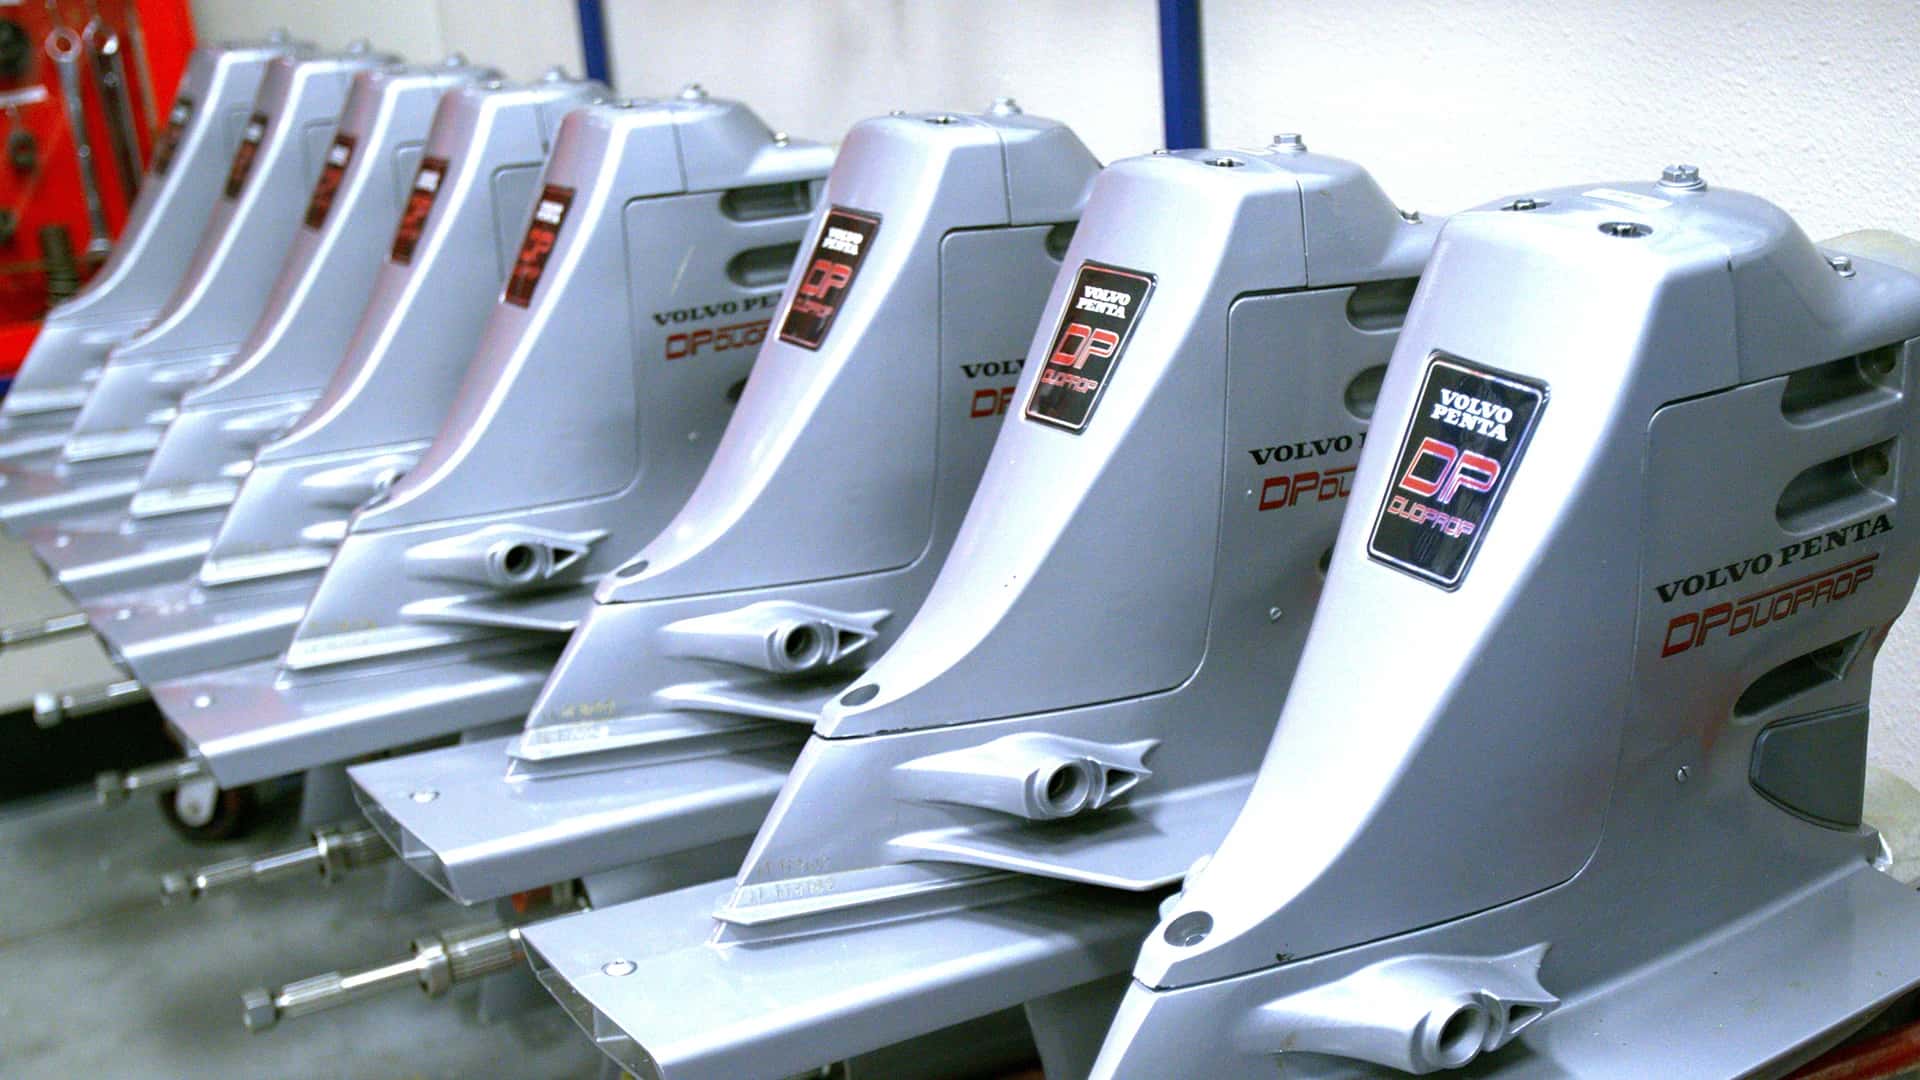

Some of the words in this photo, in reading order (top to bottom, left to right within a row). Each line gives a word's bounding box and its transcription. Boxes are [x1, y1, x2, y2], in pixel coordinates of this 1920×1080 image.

[653, 301, 738, 325] VOLVO
[1075, 297, 1126, 319] PENTA
[1082, 285, 1131, 306] VOLVO
[1050, 322, 1120, 370] DP
[1430, 403, 1508, 442] PENTA
[1439, 388, 1513, 424] VOLVO
[1248, 435, 1352, 466] VOLVO
[1399, 436, 1501, 504] DP
[1387, 495, 1476, 538] DUOPROP
[1654, 553, 1773, 604] VOLVO
[1778, 514, 1894, 568] PENTA
